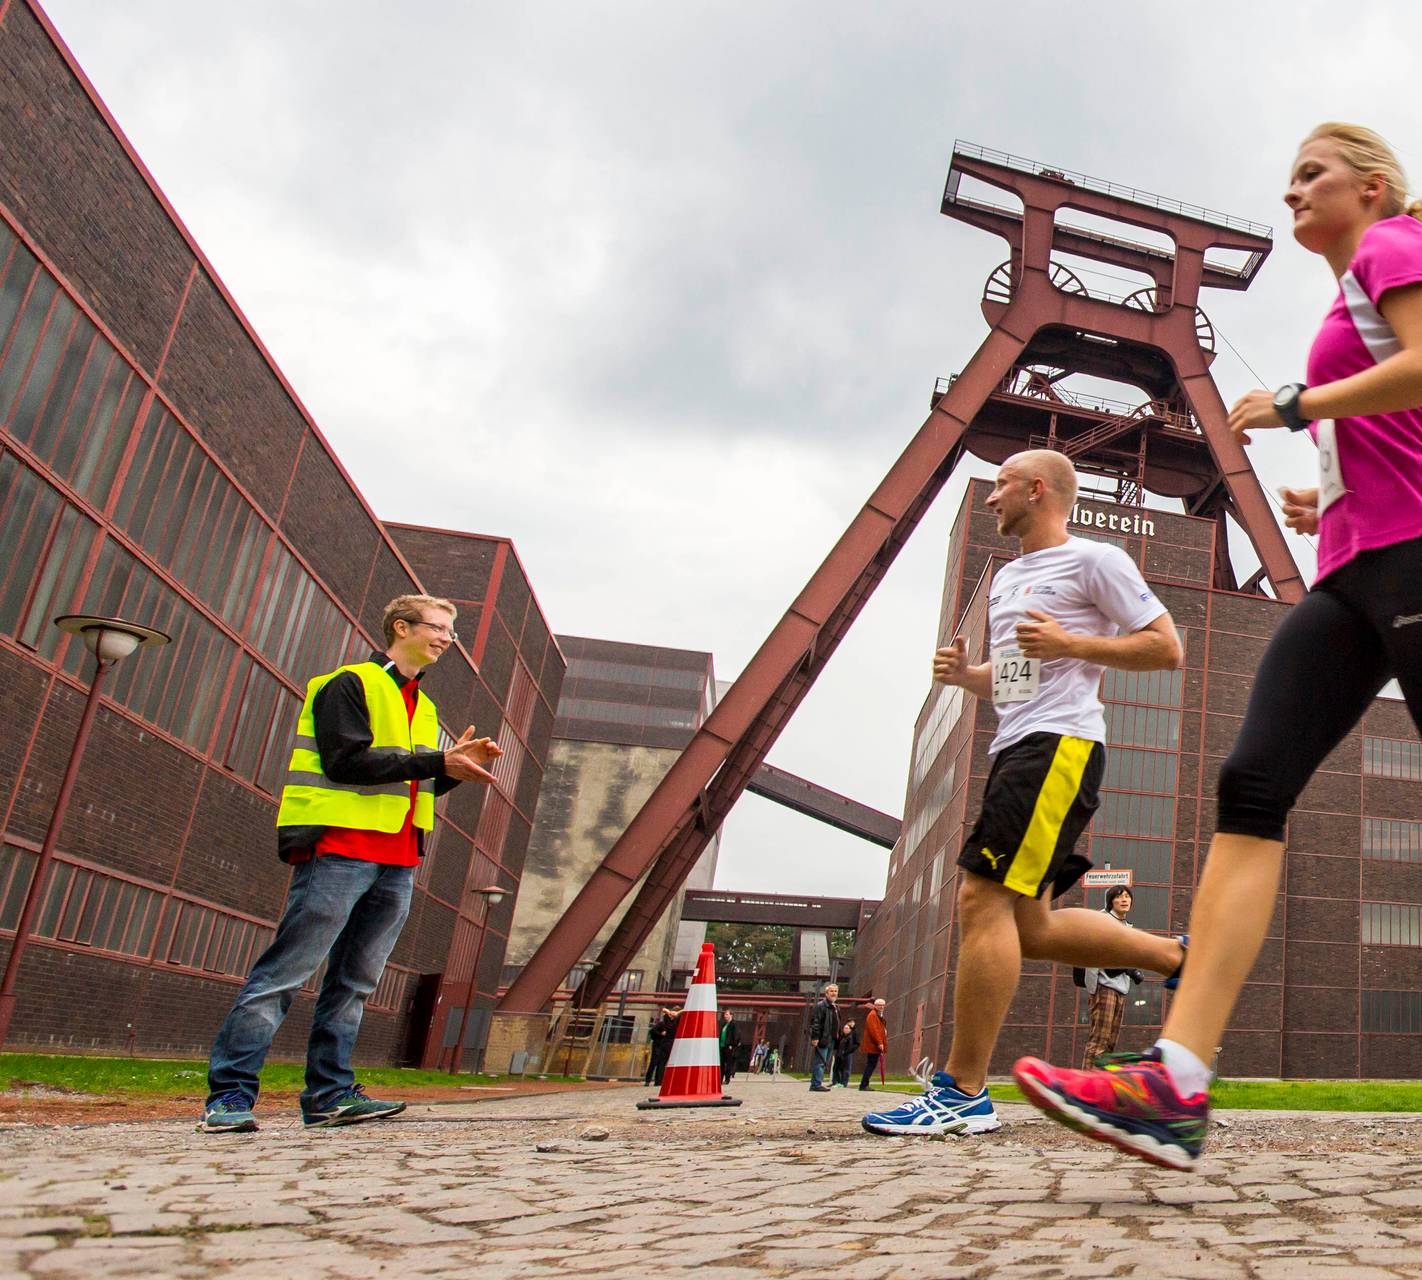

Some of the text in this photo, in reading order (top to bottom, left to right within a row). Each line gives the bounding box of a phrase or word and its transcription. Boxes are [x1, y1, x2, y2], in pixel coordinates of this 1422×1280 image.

[1066, 503, 1155, 537] lverein
[995, 660, 1032, 685] 1424
[1086, 872, 1129, 880] Feuerwehrzufahrt
